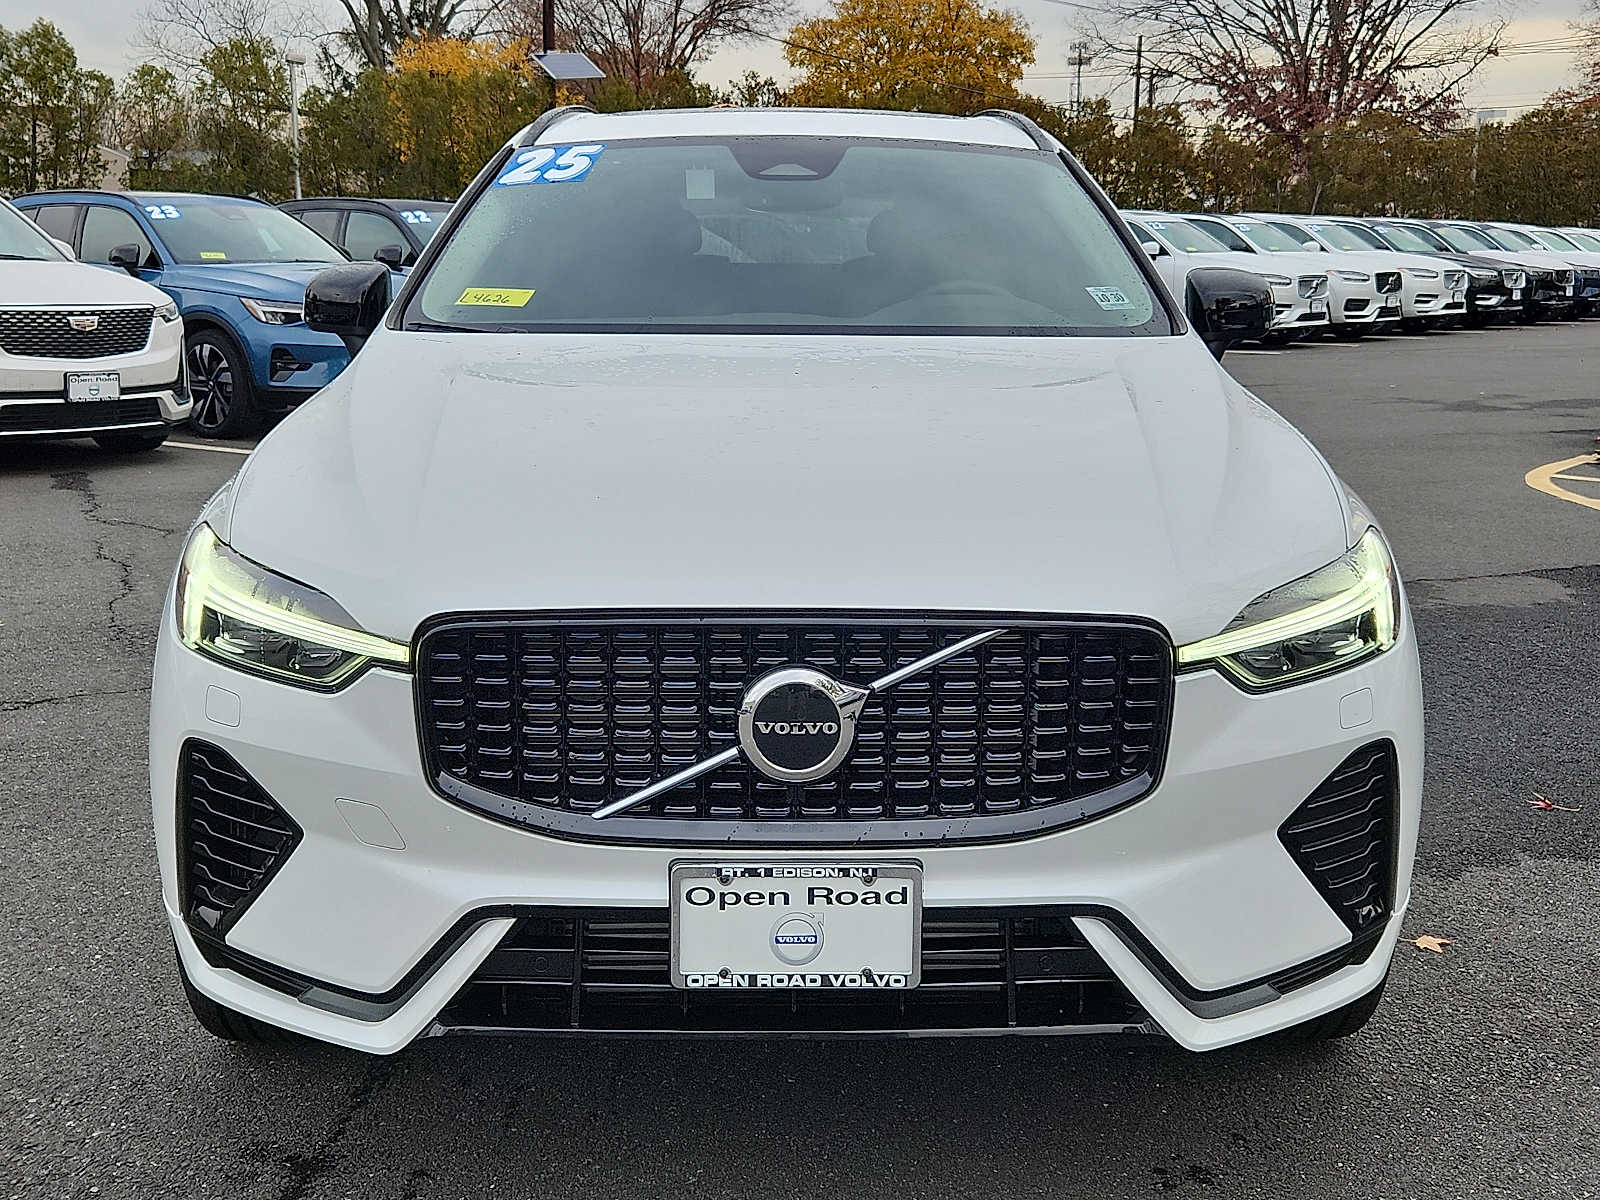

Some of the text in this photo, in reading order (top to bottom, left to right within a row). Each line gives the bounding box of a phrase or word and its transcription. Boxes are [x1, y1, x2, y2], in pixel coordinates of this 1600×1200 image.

[498, 144, 606, 185] 25
[144, 205, 181, 219] 23
[400, 210, 432, 224] 22
[755, 721, 839, 735] VOLVO
[757, 867, 765, 878] 1
[772, 867, 843, 878] EDISON,
[850, 867, 873, 878] NJ
[685, 886, 908, 910] Open Road
[686, 974, 907, 987] OPEN ROAD VOLVO
